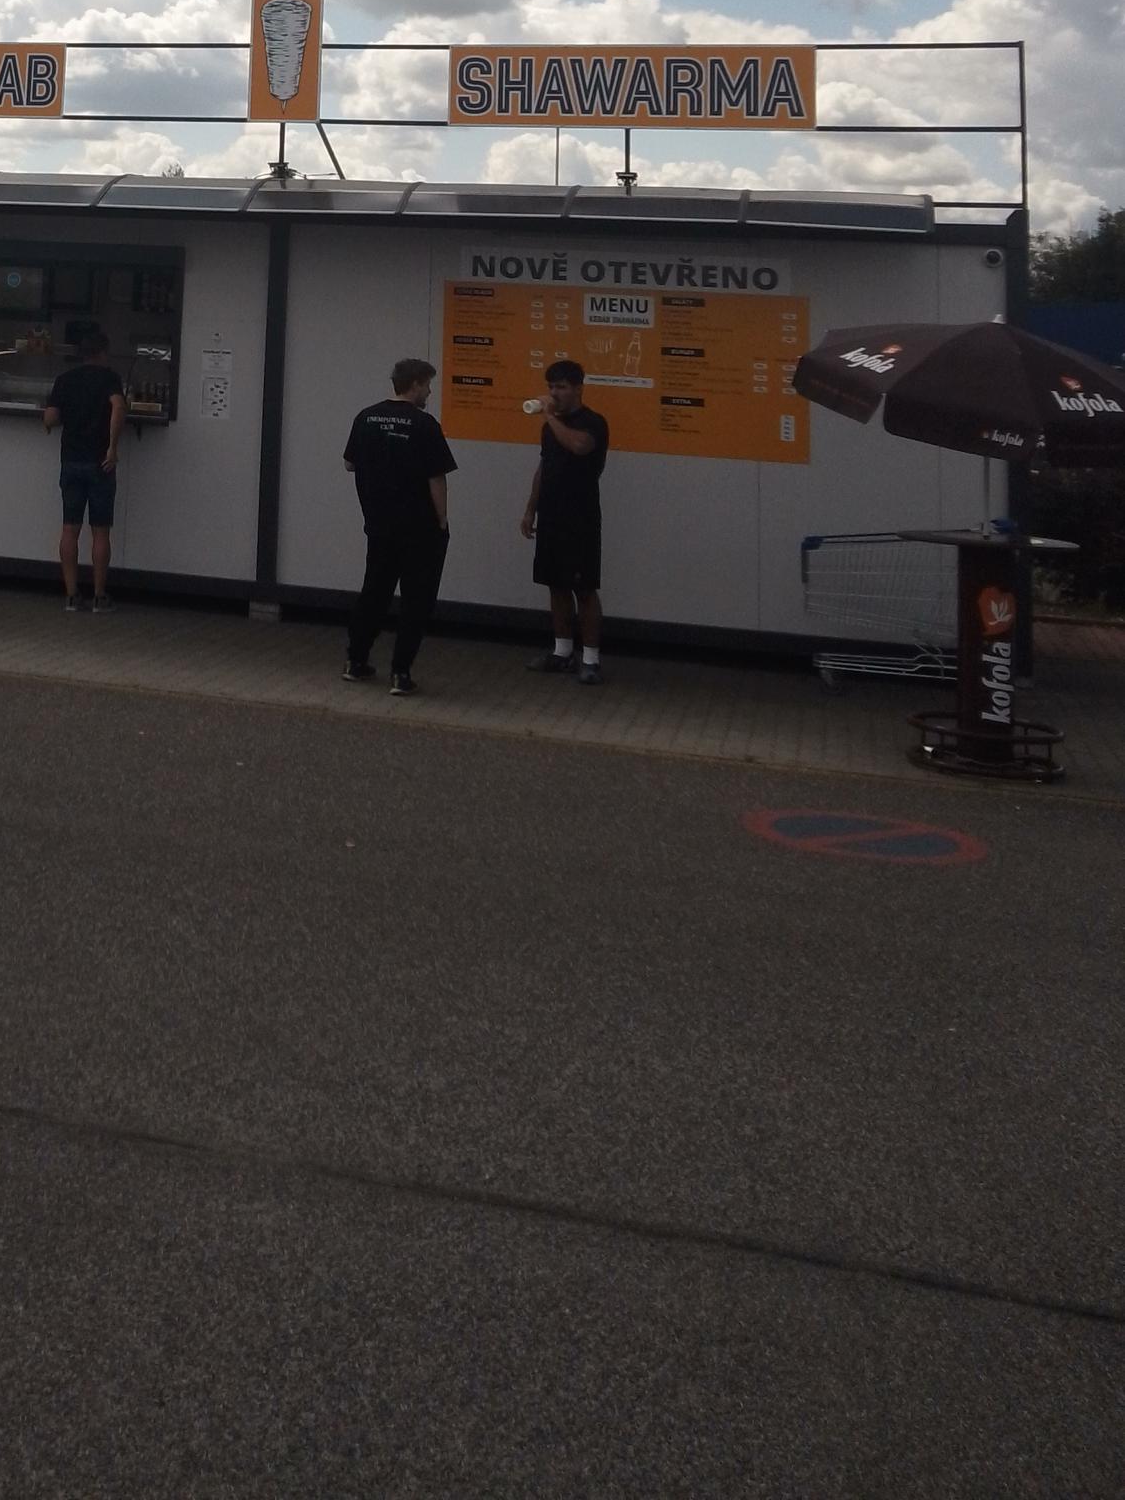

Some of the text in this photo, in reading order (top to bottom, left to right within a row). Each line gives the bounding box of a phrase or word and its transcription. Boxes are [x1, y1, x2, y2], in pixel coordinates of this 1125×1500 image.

[455, 54, 807, 120] SHAWARMA
[472, 252, 779, 291] NOVĚ OTEVŘENO
[590, 296, 649, 314] MENU
[838, 347, 896, 374] kofola
[1051, 389, 1124, 418] kofola
[991, 429, 1024, 447] kofola
[981, 640, 1012, 725] kofola
